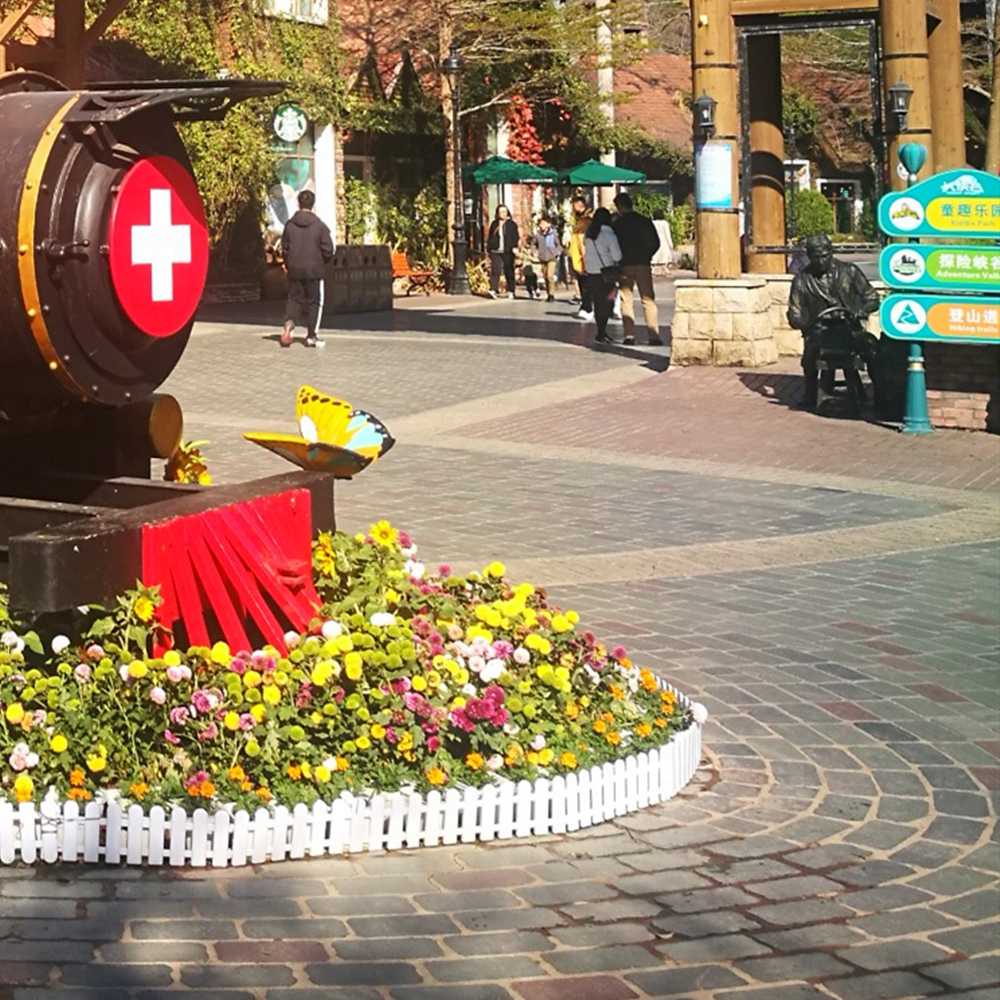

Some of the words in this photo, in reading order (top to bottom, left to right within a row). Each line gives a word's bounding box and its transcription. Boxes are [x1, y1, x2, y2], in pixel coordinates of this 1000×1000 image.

[936, 270, 980, 279] Adventure
[949, 308, 998, 324] 登山道
